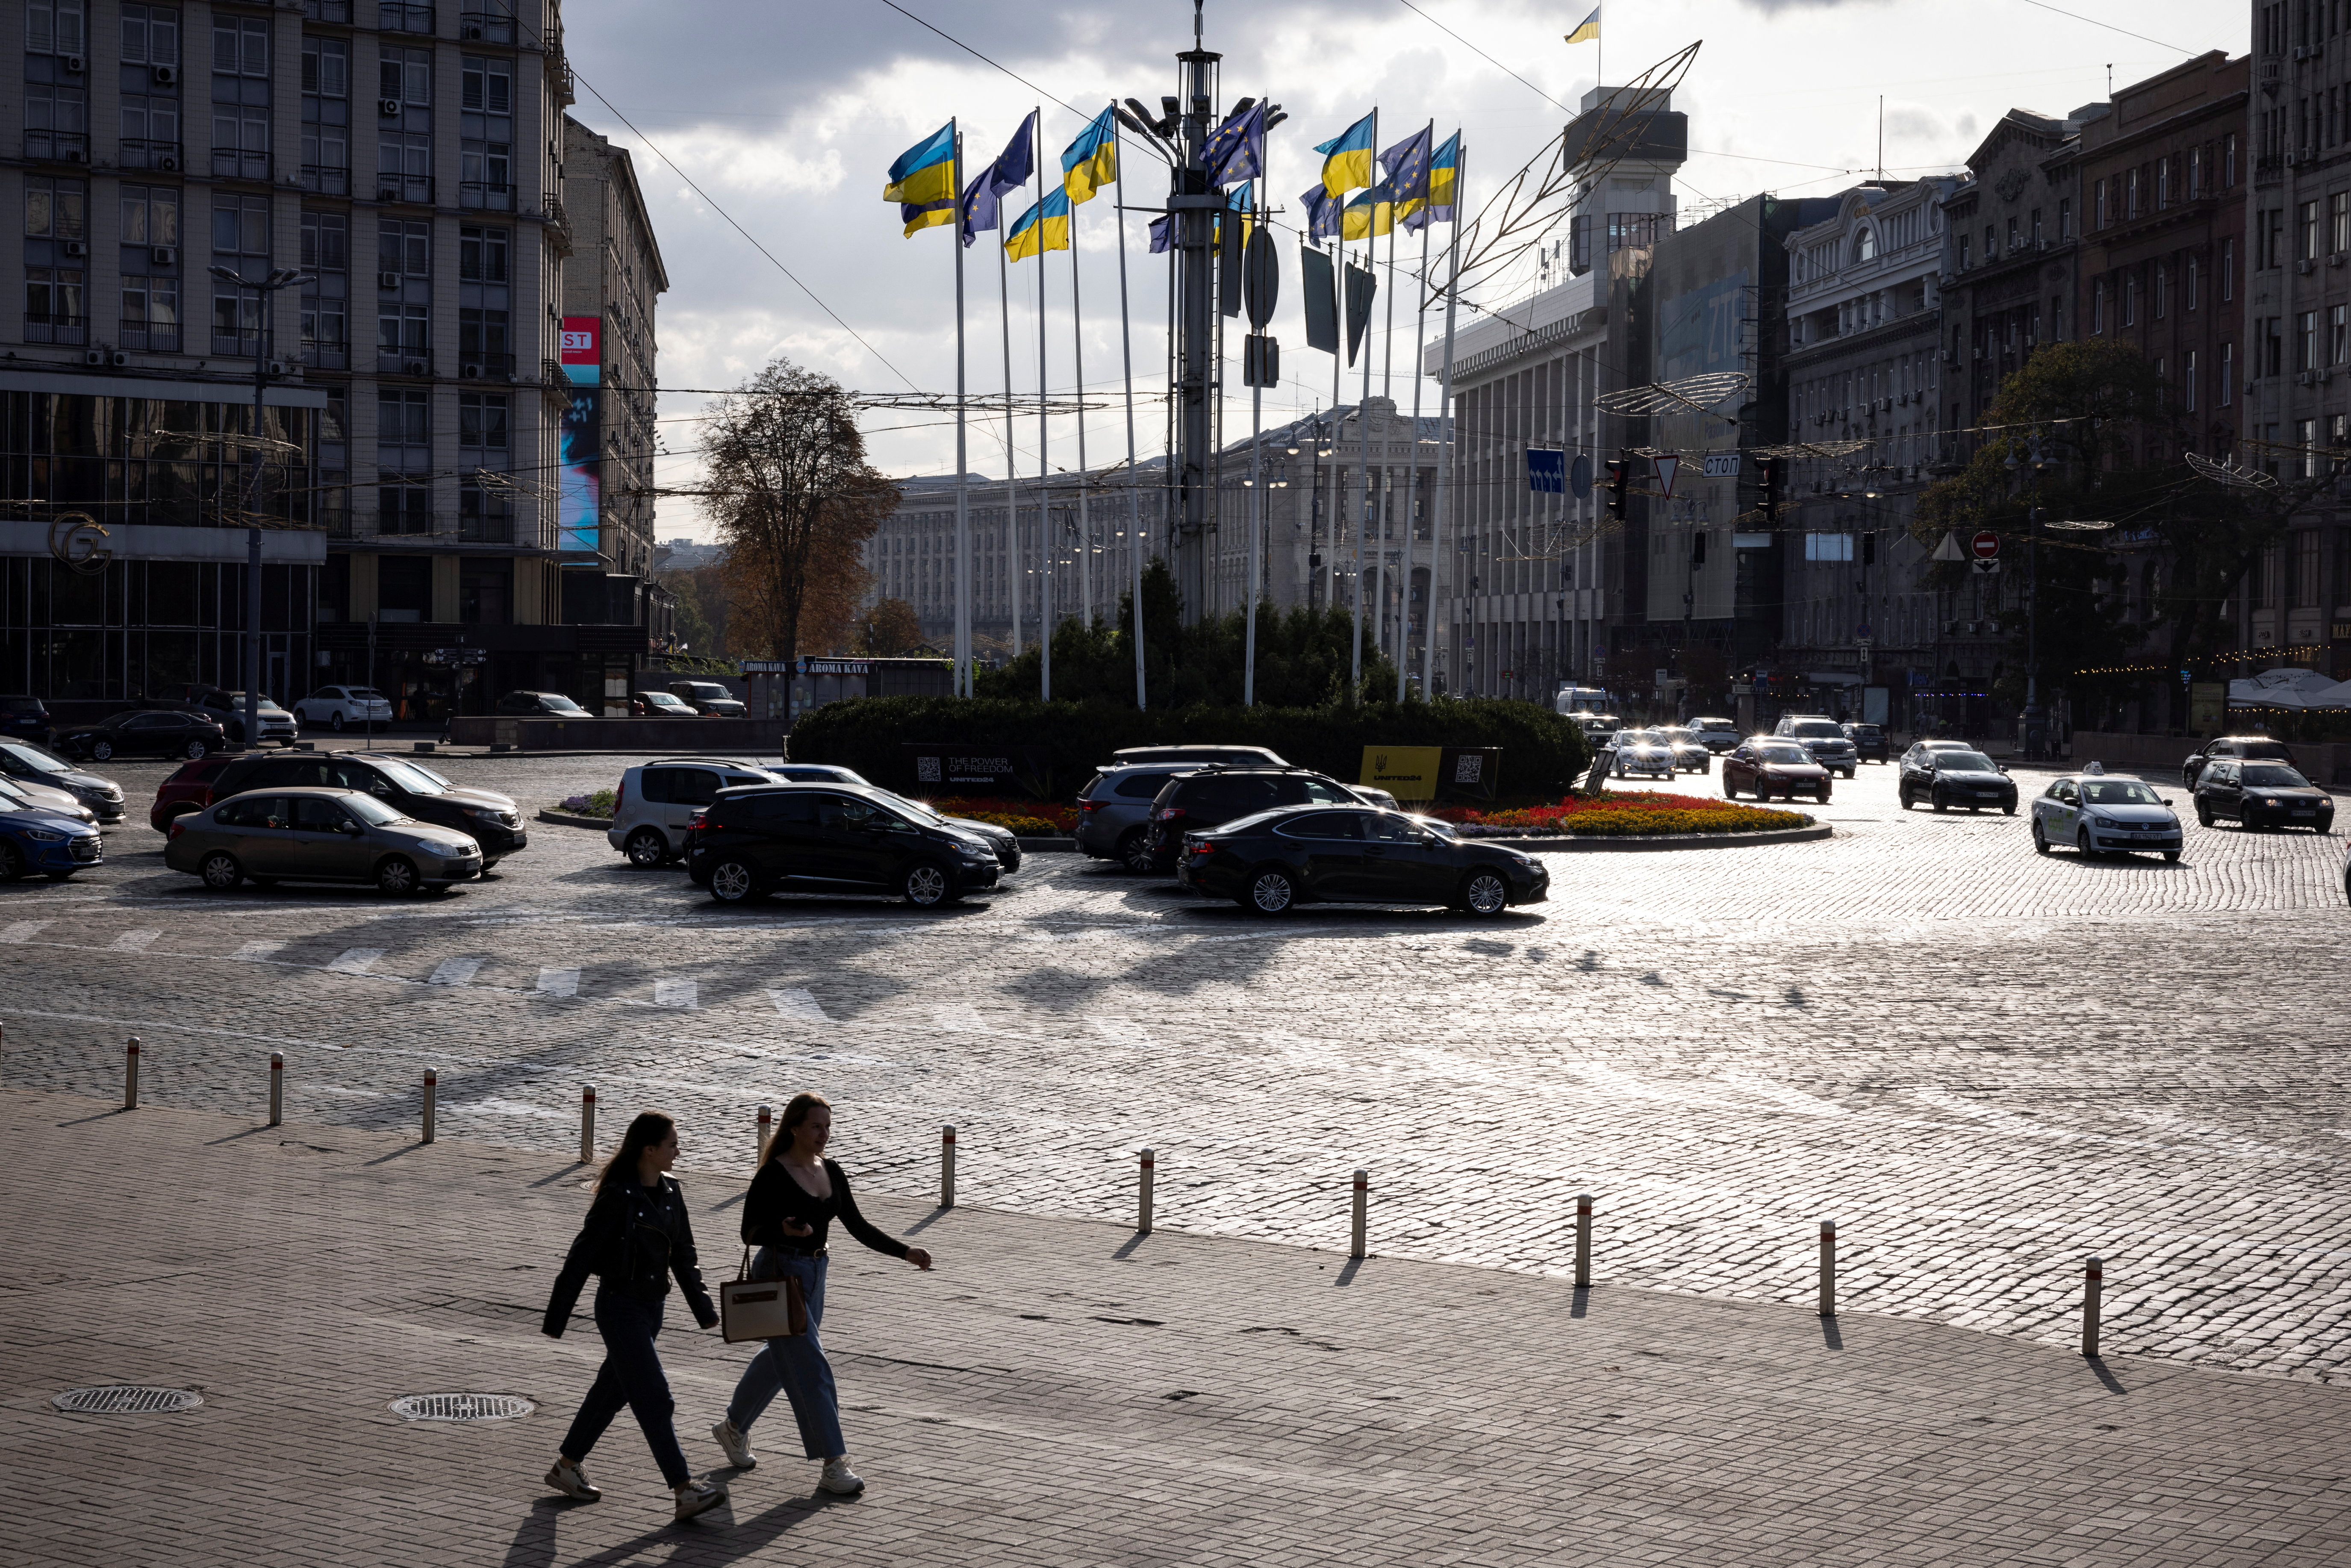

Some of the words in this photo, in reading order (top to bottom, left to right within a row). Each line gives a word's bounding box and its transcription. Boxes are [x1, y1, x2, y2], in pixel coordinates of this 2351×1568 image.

[1706, 457, 1738, 474] СТОП
[745, 662, 767, 671] AROMA
[768, 663, 786, 672] KAVA
[808, 663, 842, 673] AROMA
[843, 664, 869, 674] KAVA
